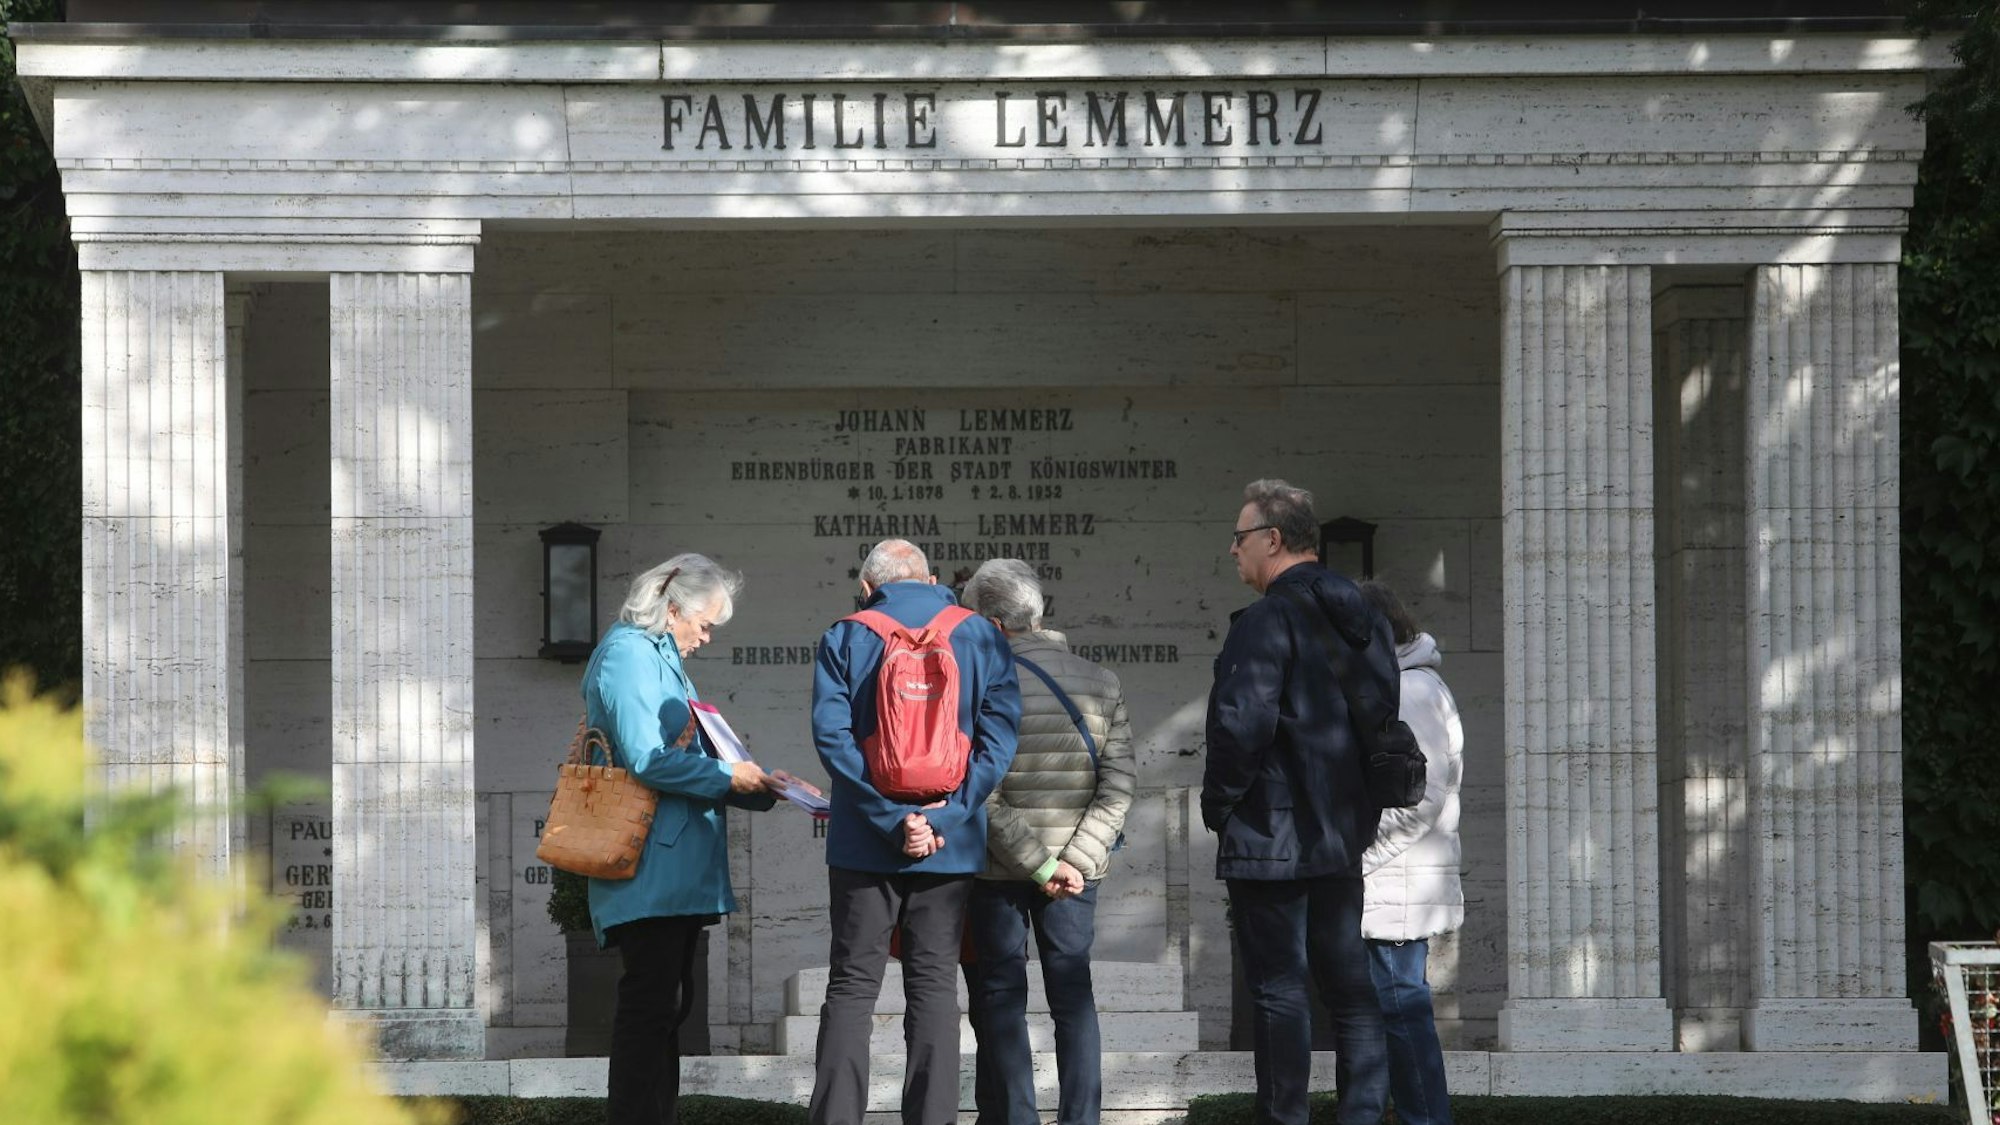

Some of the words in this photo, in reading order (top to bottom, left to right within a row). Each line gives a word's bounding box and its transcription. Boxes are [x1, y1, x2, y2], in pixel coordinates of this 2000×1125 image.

[661, 93, 938, 150] FAMILIE
[994, 88, 1324, 147] LEMMERZ
[834, 409, 926, 431] JOHANN
[960, 408, 1074, 431] LEMMERZ
[895, 437, 1013, 455] FABRIKANT
[731, 458, 875, 480] EHRENBÜRGER
[894, 460, 934, 480] DER
[951, 460, 1012, 480] STADT
[1030, 457, 1177, 480] KÖNIGSWINTER
[814, 514, 942, 537] KATHARINA
[978, 513, 1096, 536] LEMMERZ
[1071, 644, 1180, 663] IGSWINTER
[291, 822, 332, 840] PAU
[286, 865, 332, 886] GER
